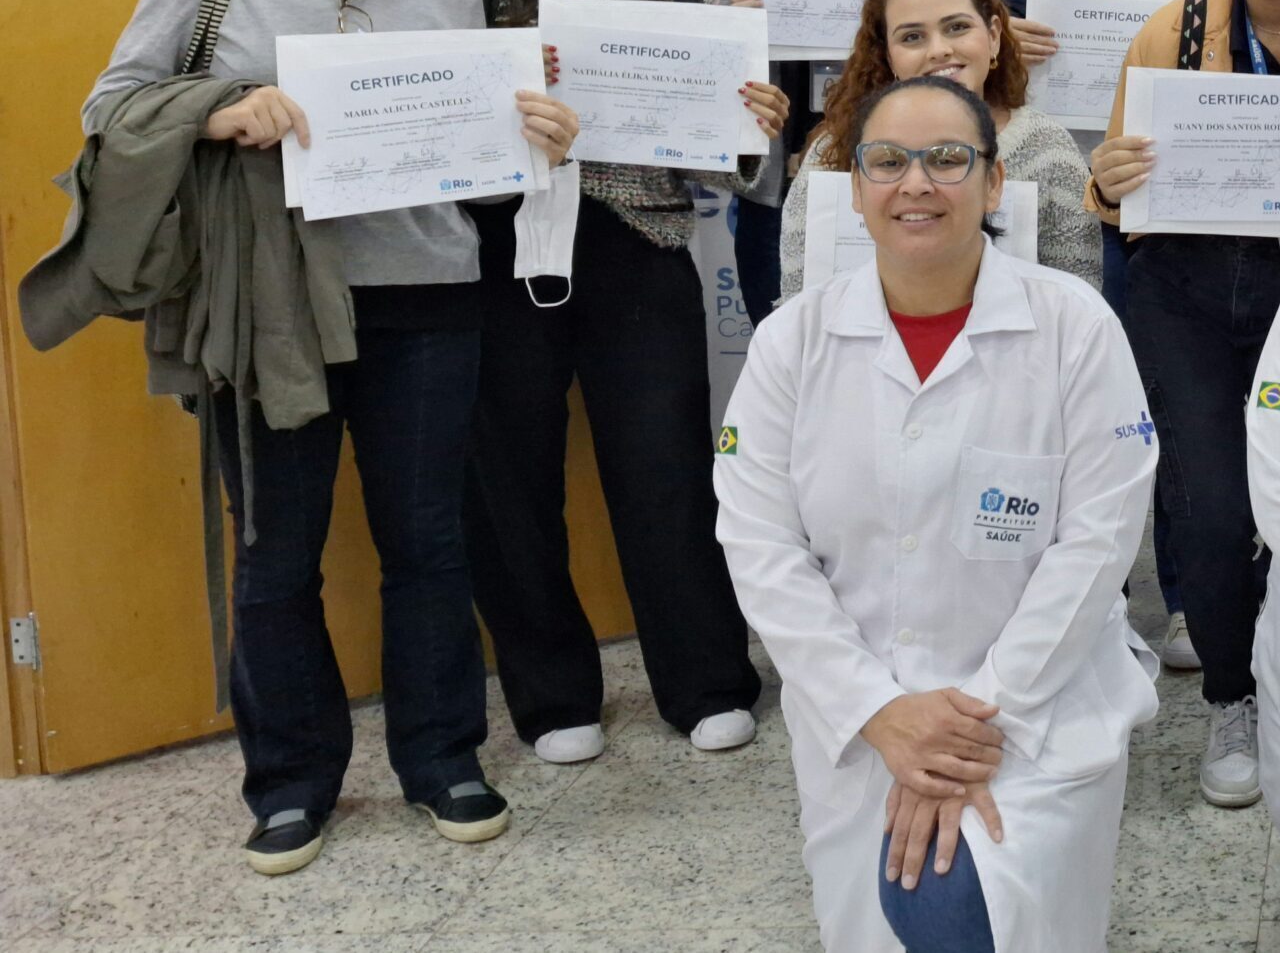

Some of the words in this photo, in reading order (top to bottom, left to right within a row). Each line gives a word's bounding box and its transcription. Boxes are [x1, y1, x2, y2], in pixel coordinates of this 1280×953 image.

[1073, 9, 1150, 23] CERTIFICADO
[599, 42, 691, 61] CERTIFICADO
[350, 69, 455, 92] CERTIFICADO
[650, 74, 679, 84] SILVA
[343, 106, 381, 120] MARIA
[1173, 123, 1204, 131] SUANY
[1205, 123, 1225, 132] DOS
[1226, 123, 1262, 132] SANTOS
[666, 148, 684, 158] Rio
[452, 179, 473, 189] Rio
[1115, 424, 1137, 440] SUS
[1005, 496, 1040, 516] Rio
[975, 514, 1038, 527] PREFEITURA
[985, 531, 1022, 543] SAÚDE
